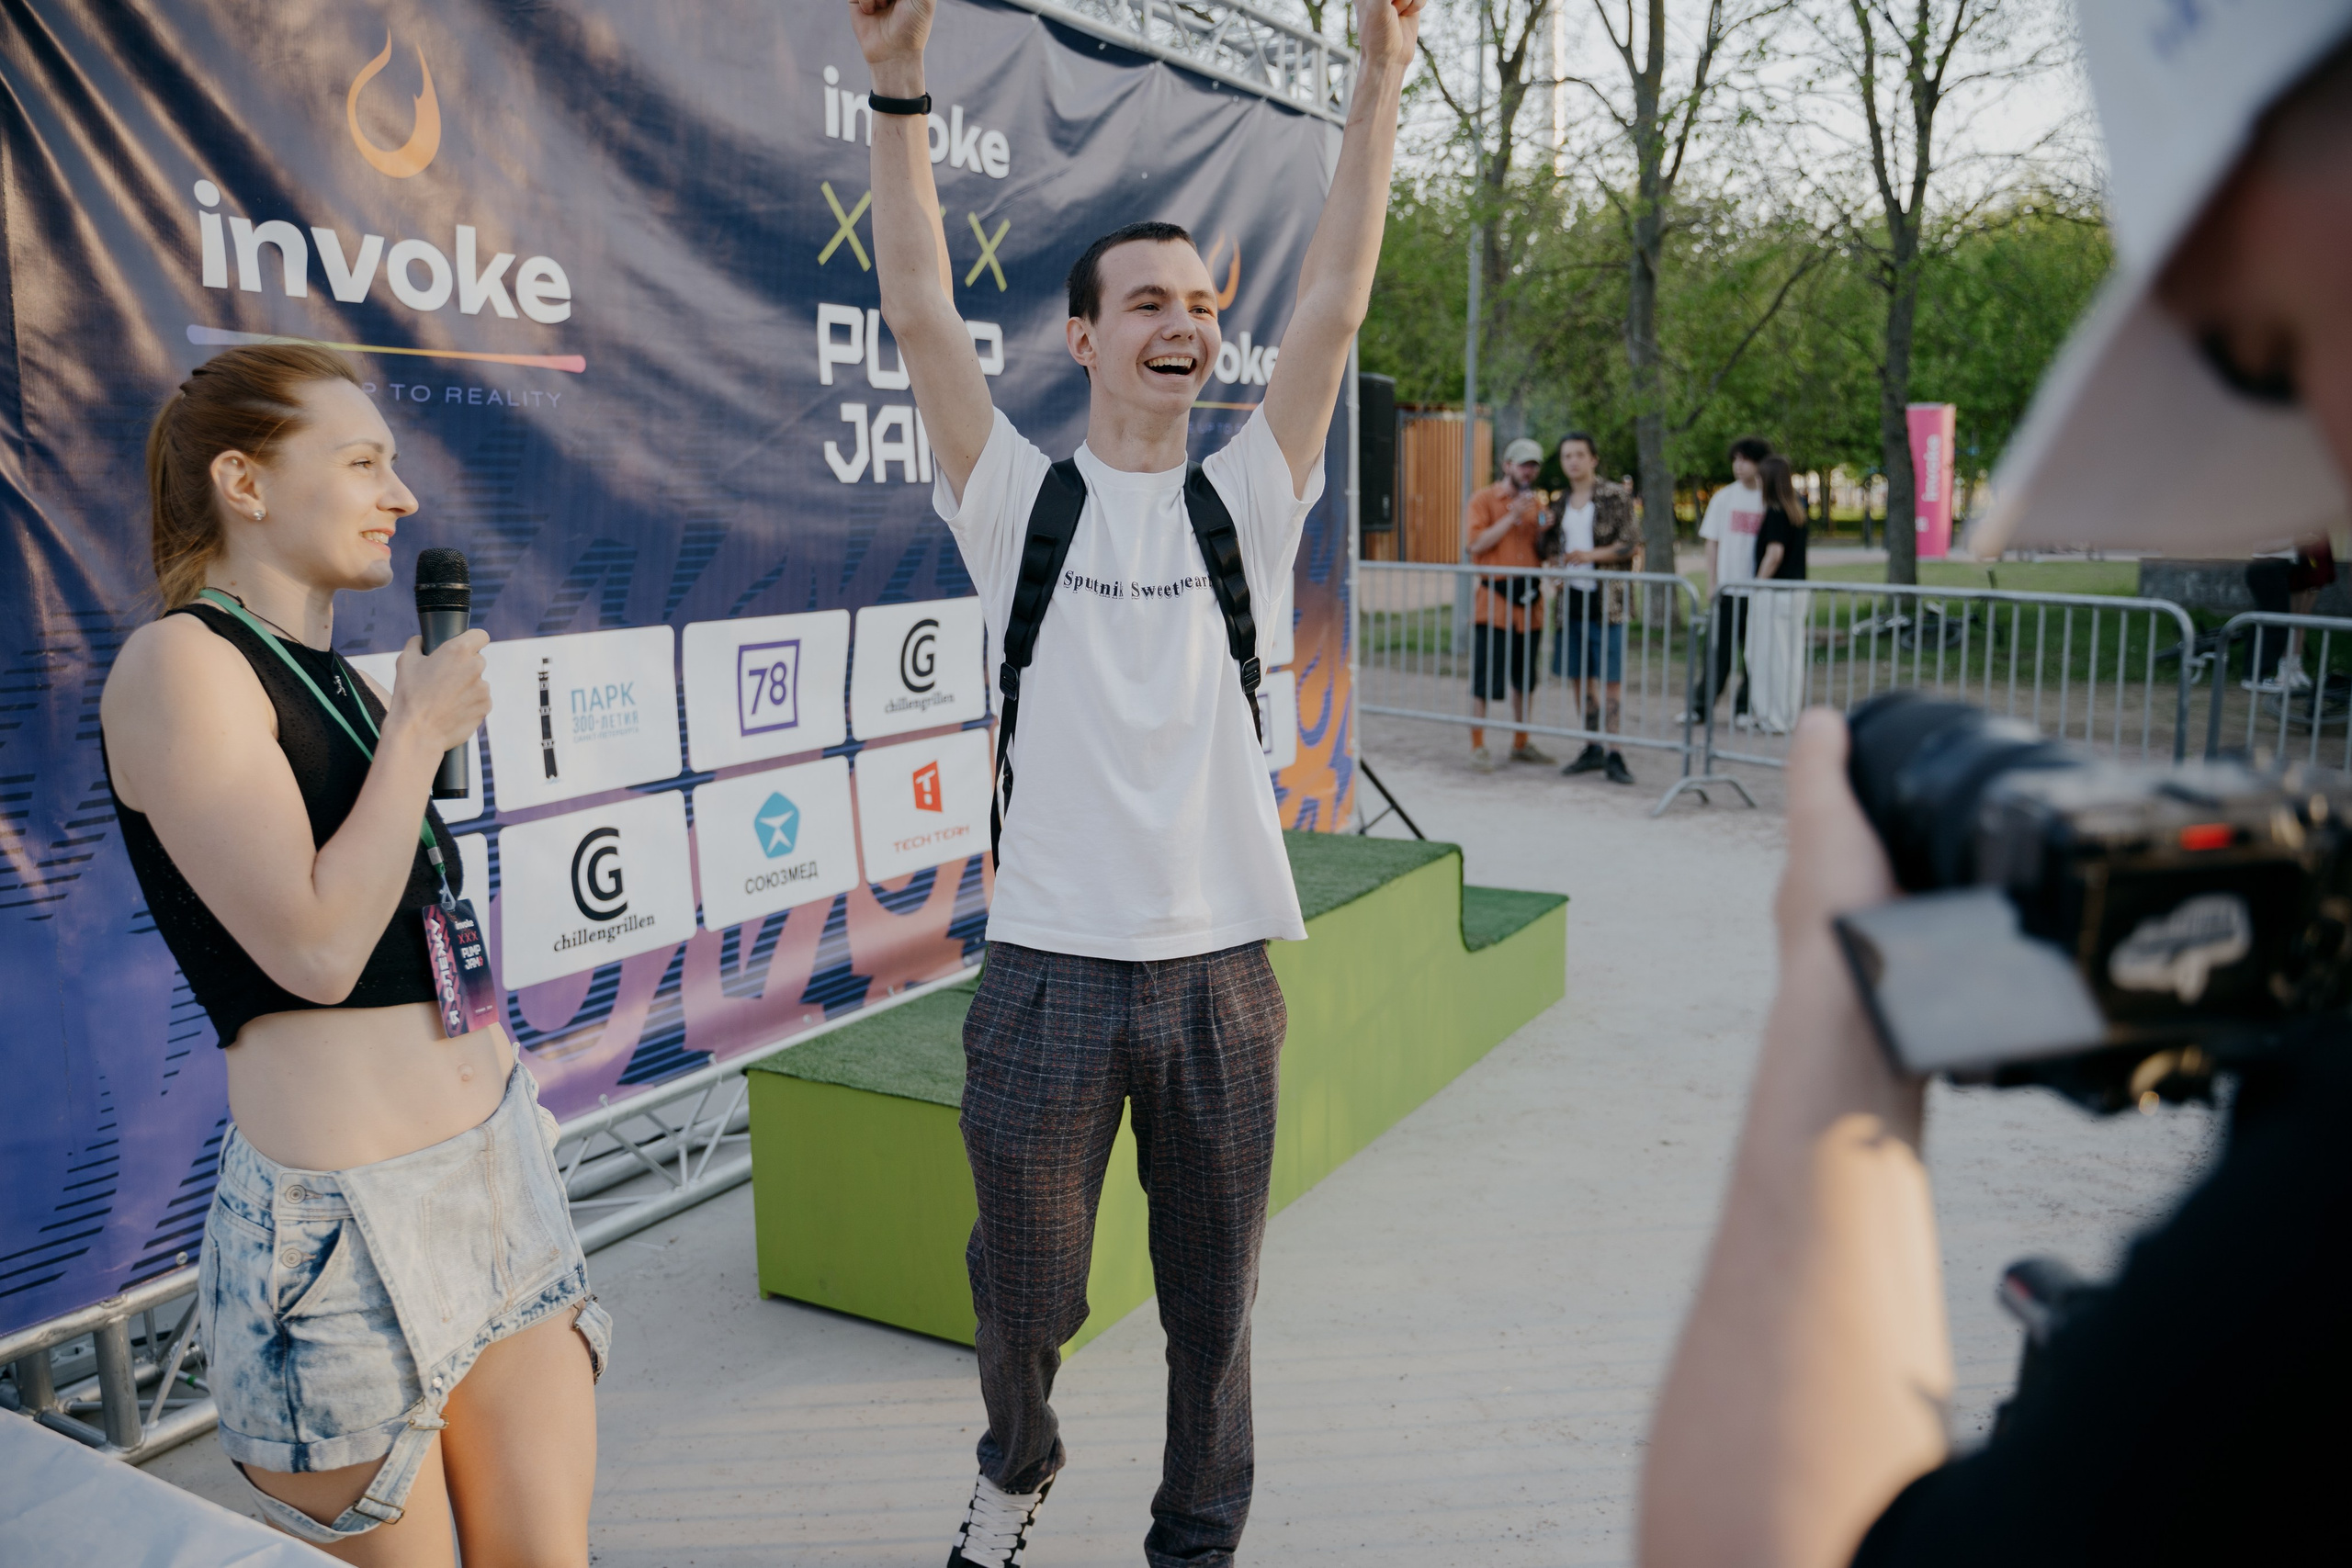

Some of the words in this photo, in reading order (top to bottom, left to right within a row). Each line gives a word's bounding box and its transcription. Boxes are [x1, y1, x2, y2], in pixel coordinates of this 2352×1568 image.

[823, 65, 1010, 179] inoke
[194, 179, 571, 324] invoke
[817, 302, 1004, 390] PUP
[1215, 332, 1280, 386] oke
[390, 383, 431, 402] TO
[445, 386, 562, 408] REALITY
[824, 402, 933, 483] JA
[571, 682, 636, 714] ПАРК
[749, 661, 787, 715] 78
[572, 710, 639, 734] 300-ЛЕТИЯ
[894, 835, 932, 852] TECH
[934, 825, 970, 841] TEAM
[745, 861, 818, 895] СОЮЗМЕД
[458, 931, 479, 944] XXX
[554, 915, 655, 952] chillengrillen
[461, 944, 481, 958] PUMP
[449, 1010, 460, 1025] Я
